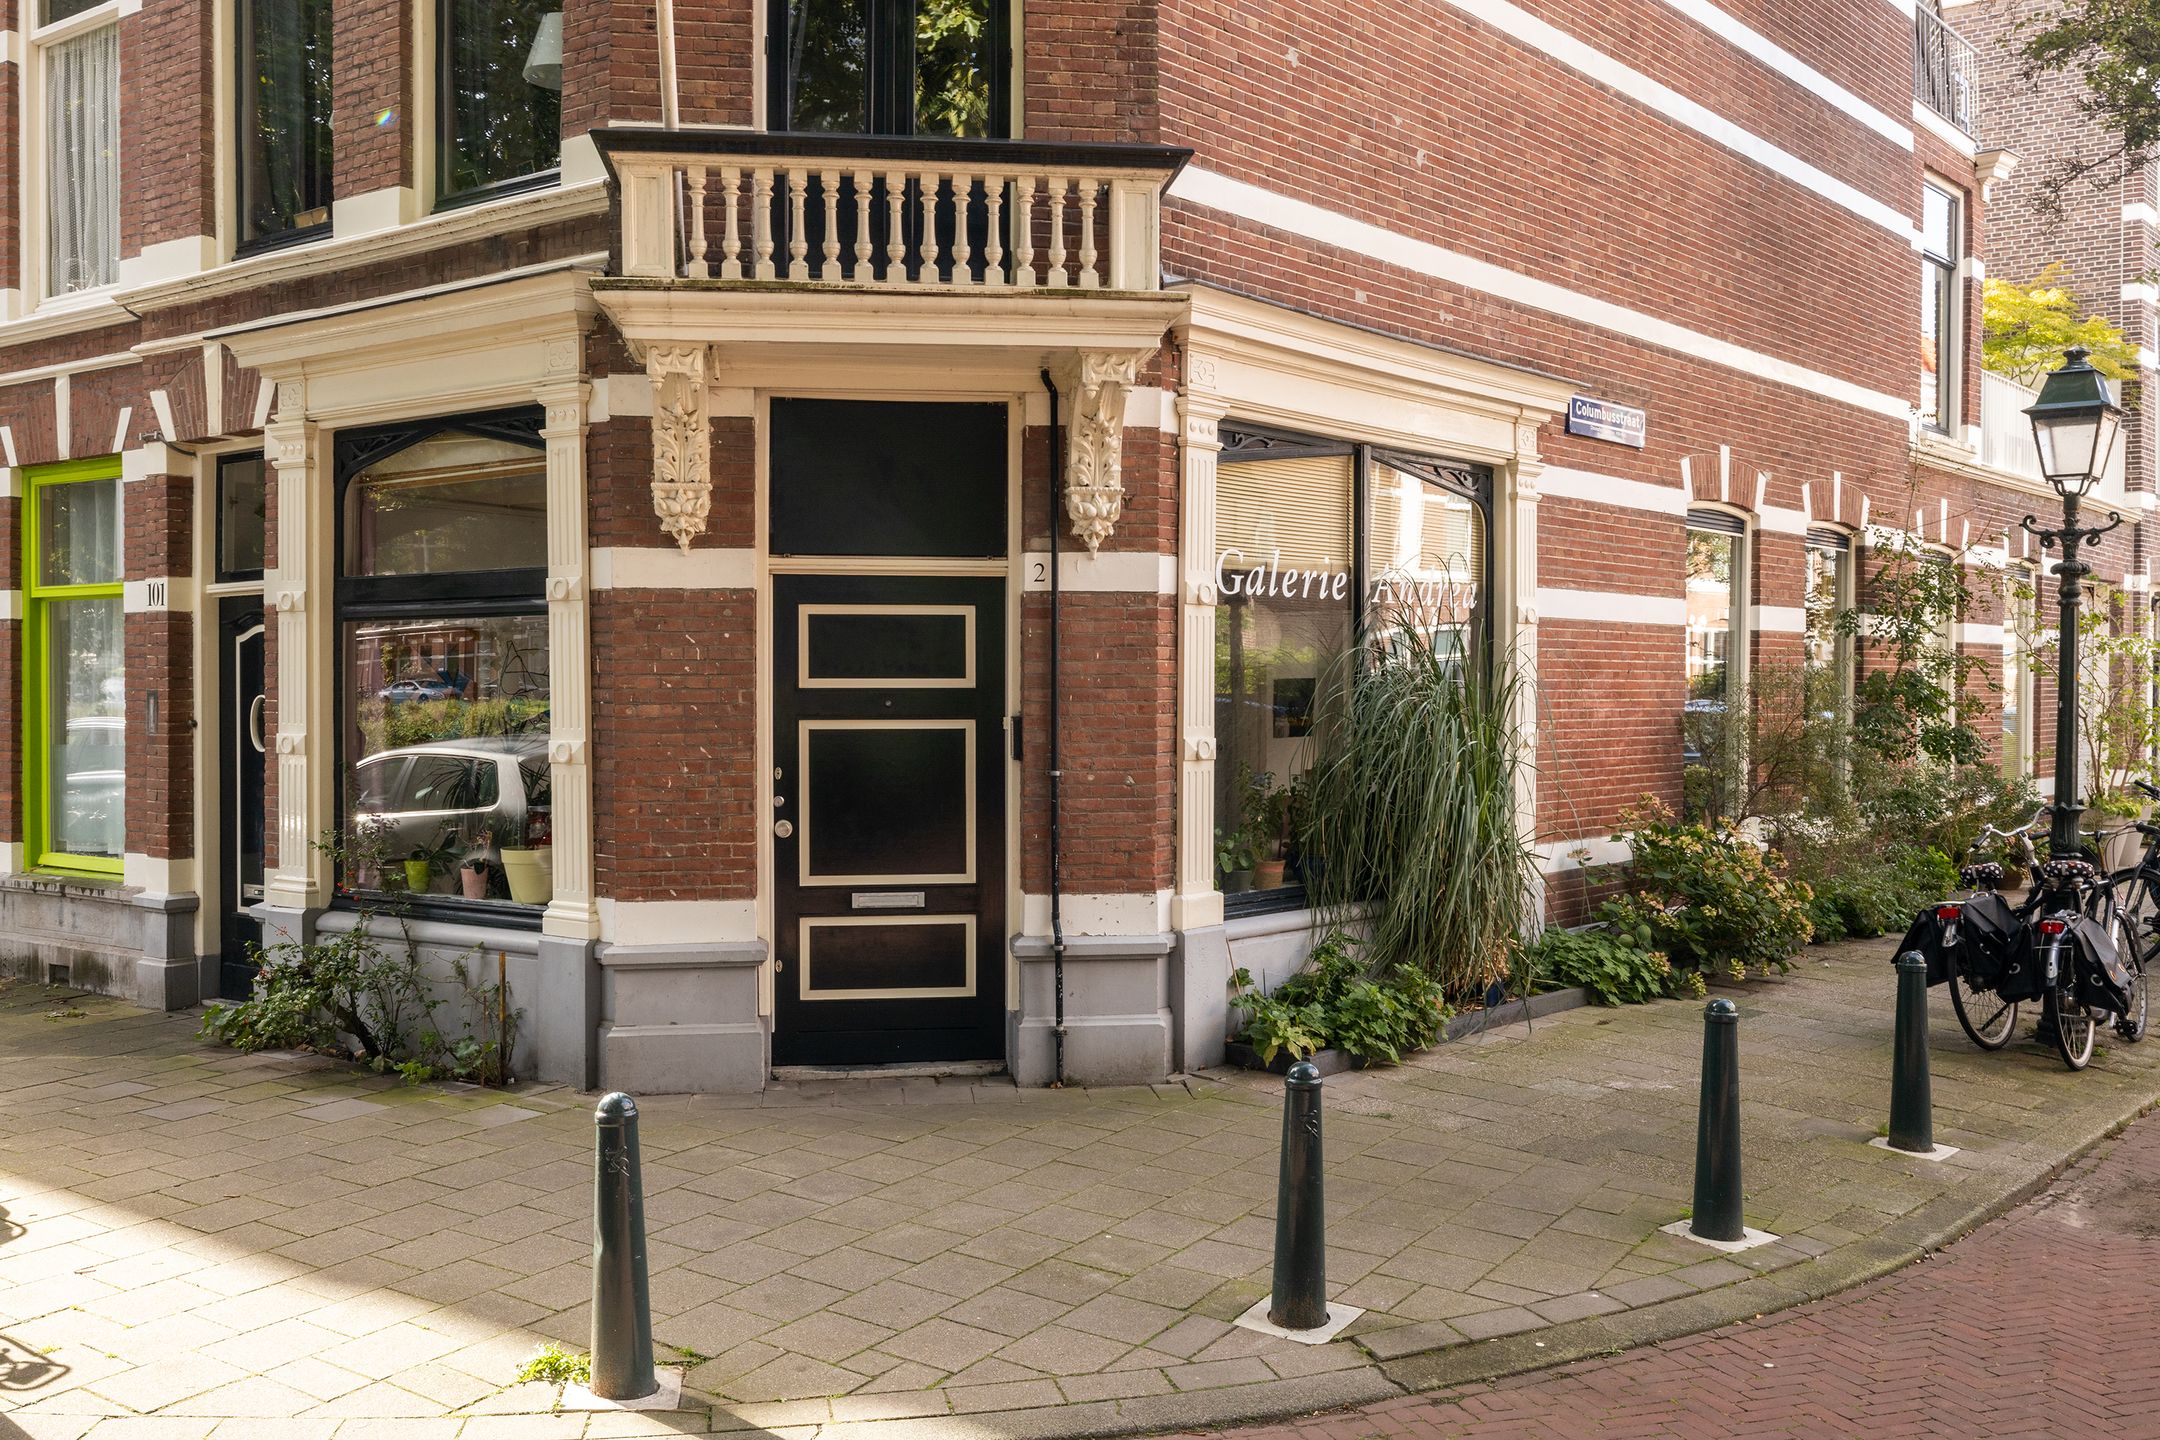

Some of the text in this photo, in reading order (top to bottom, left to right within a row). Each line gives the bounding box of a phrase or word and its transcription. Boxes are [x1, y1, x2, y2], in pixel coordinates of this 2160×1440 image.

[1575, 401, 1641, 428] Columbusstraat
[1033, 562, 1046, 583] 2
[1215, 549, 1478, 609] Galerie Andrea
[146, 582, 166, 607] 101
